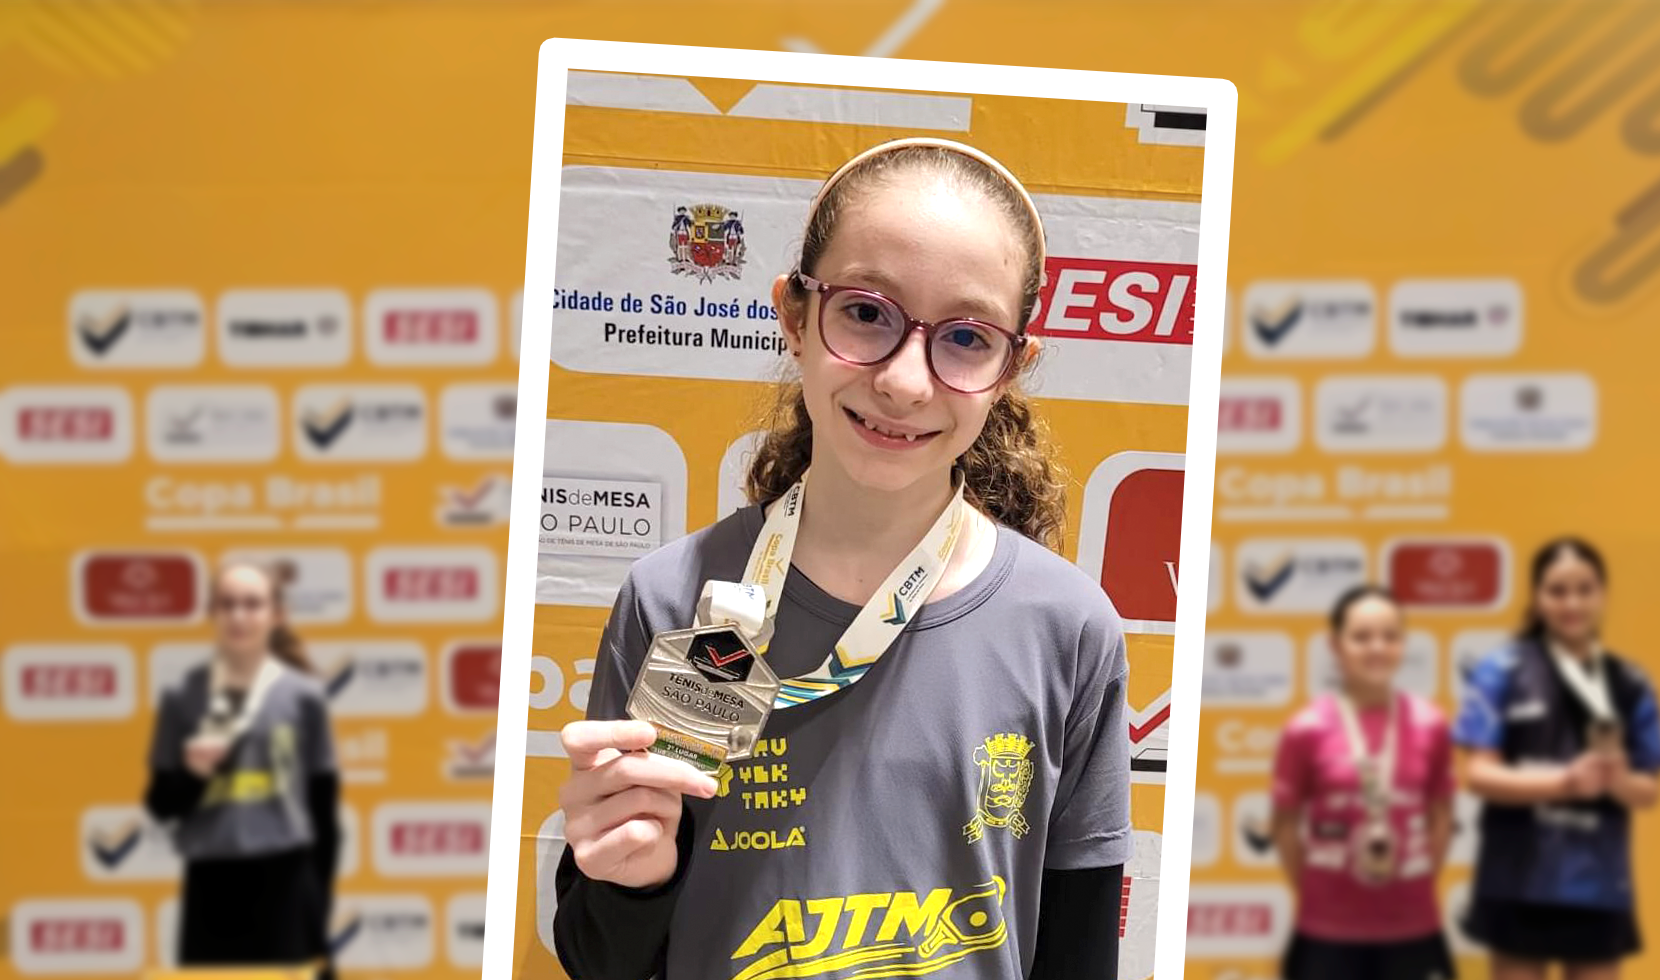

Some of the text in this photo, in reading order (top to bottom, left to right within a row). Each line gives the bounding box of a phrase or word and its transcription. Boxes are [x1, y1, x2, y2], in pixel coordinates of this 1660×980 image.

[553, 289, 613, 311] Cidade
[621, 293, 642, 313] de
[651, 294, 686, 316] São
[694, 297, 739, 319] José
[605, 323, 787, 356] Prefeitura Municip
[541, 488, 650, 508] NISdeMESA
[569, 515, 650, 536] PAULO
[898, 566, 925, 596] CBTM
[662, 686, 740, 722] SÃO PAULO
[730, 826, 806, 850] JOOLA
[731, 887, 952, 960] AJTM
